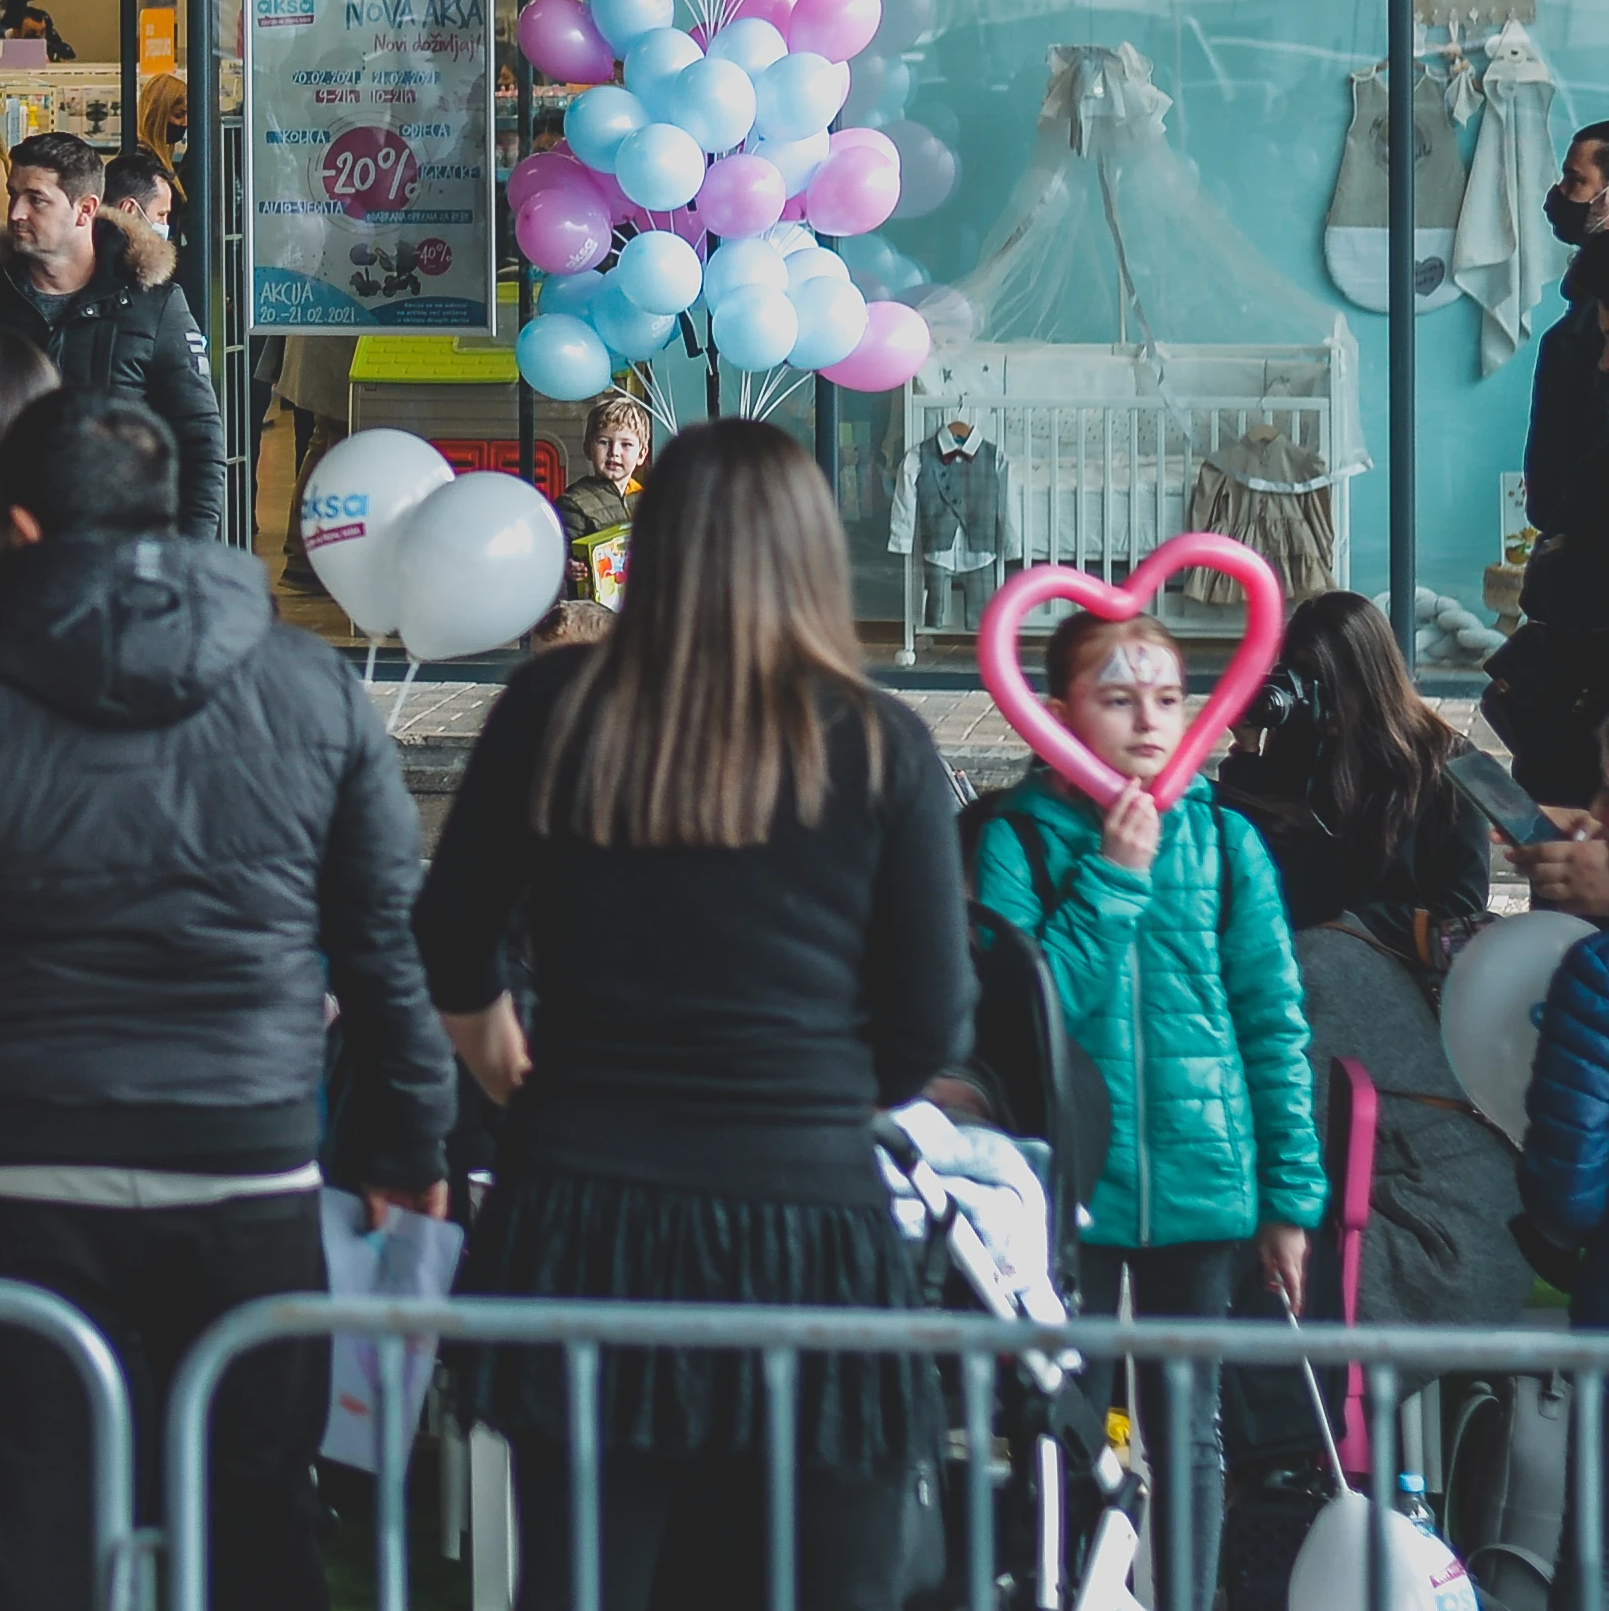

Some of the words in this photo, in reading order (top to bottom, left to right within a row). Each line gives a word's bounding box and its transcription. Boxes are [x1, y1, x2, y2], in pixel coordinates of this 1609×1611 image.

[373, 33, 408, 53] Novi
[321, 147, 420, 200] -20%
[260, 281, 314, 305] AKCIJA
